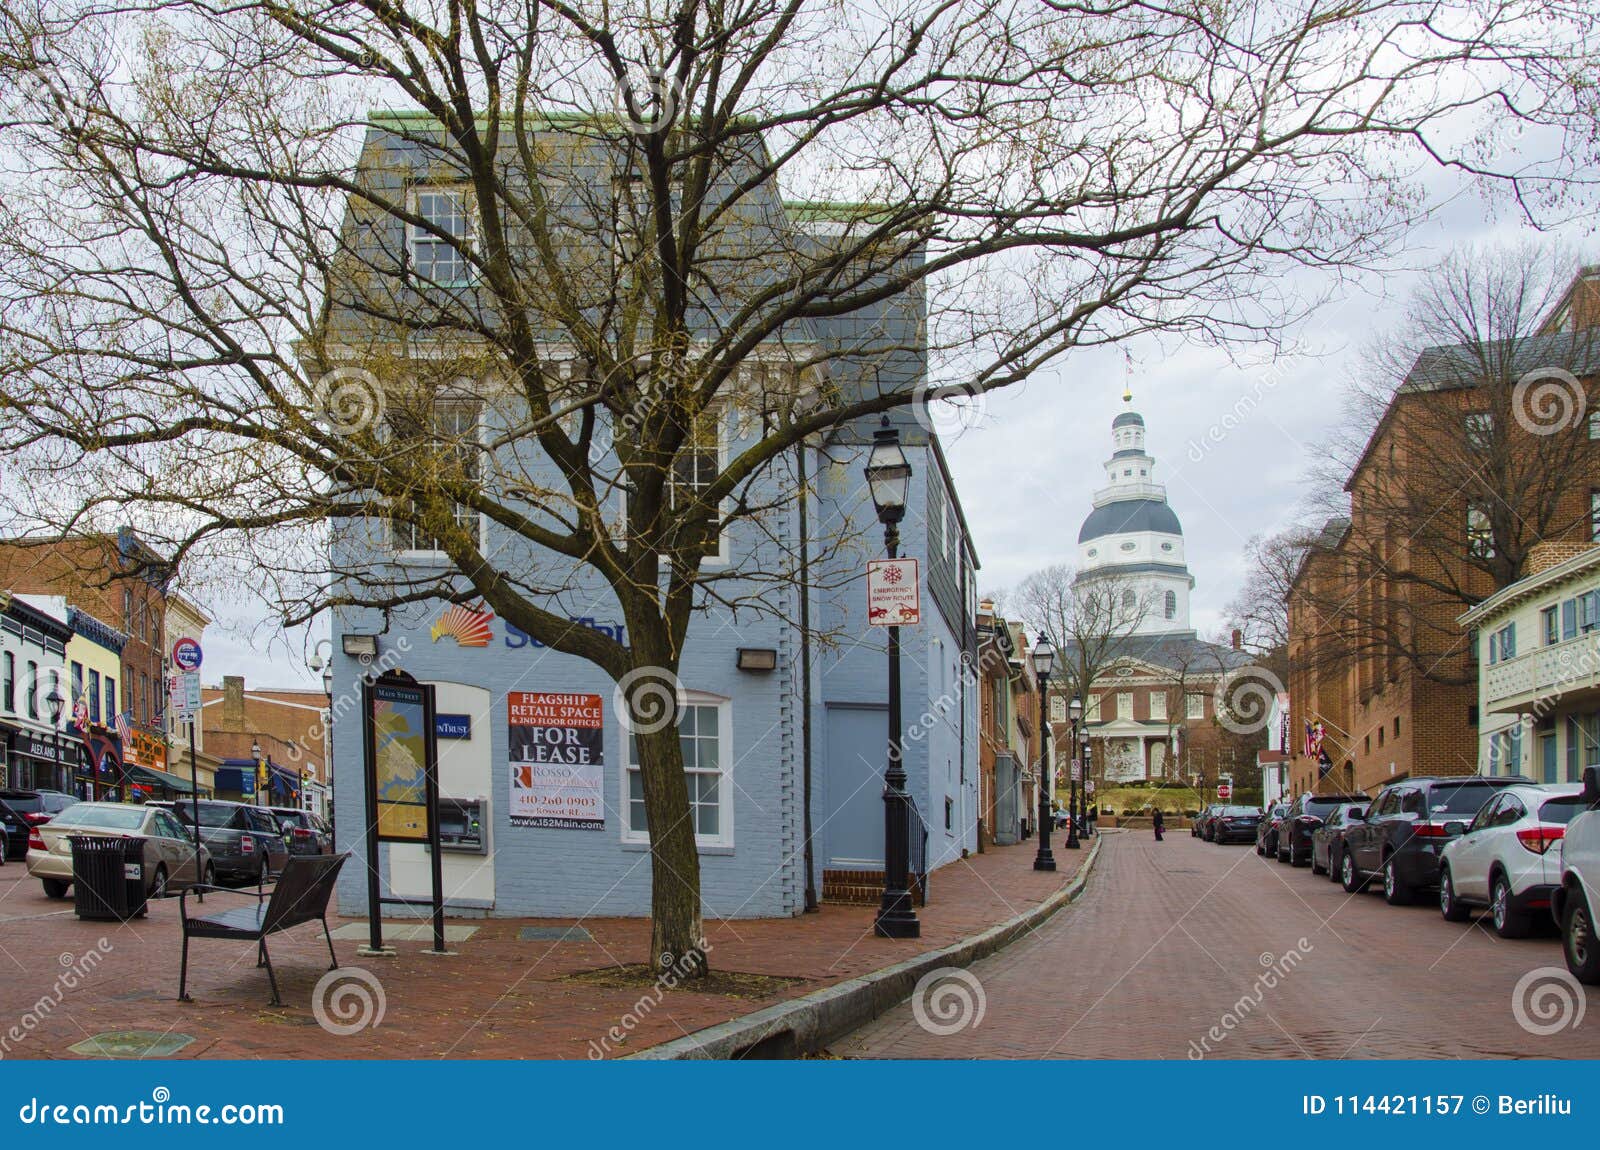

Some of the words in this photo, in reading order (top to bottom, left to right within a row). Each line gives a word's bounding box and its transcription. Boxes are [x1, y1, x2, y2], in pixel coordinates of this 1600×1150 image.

[522, 693, 588, 706] FLAGSHIP
[511, 705, 557, 717] RETAIL
[560, 706, 601, 718] SPACE
[519, 717, 537, 725] 2ND
[538, 717, 566, 726] FLOOR
[567, 719, 601, 728] OFFICES
[532, 726, 581, 745] FOR
[521, 744, 591, 764] LEASE
[533, 766, 571, 777] ROSSO
[511, 817, 602, 829] www.152Main.com
